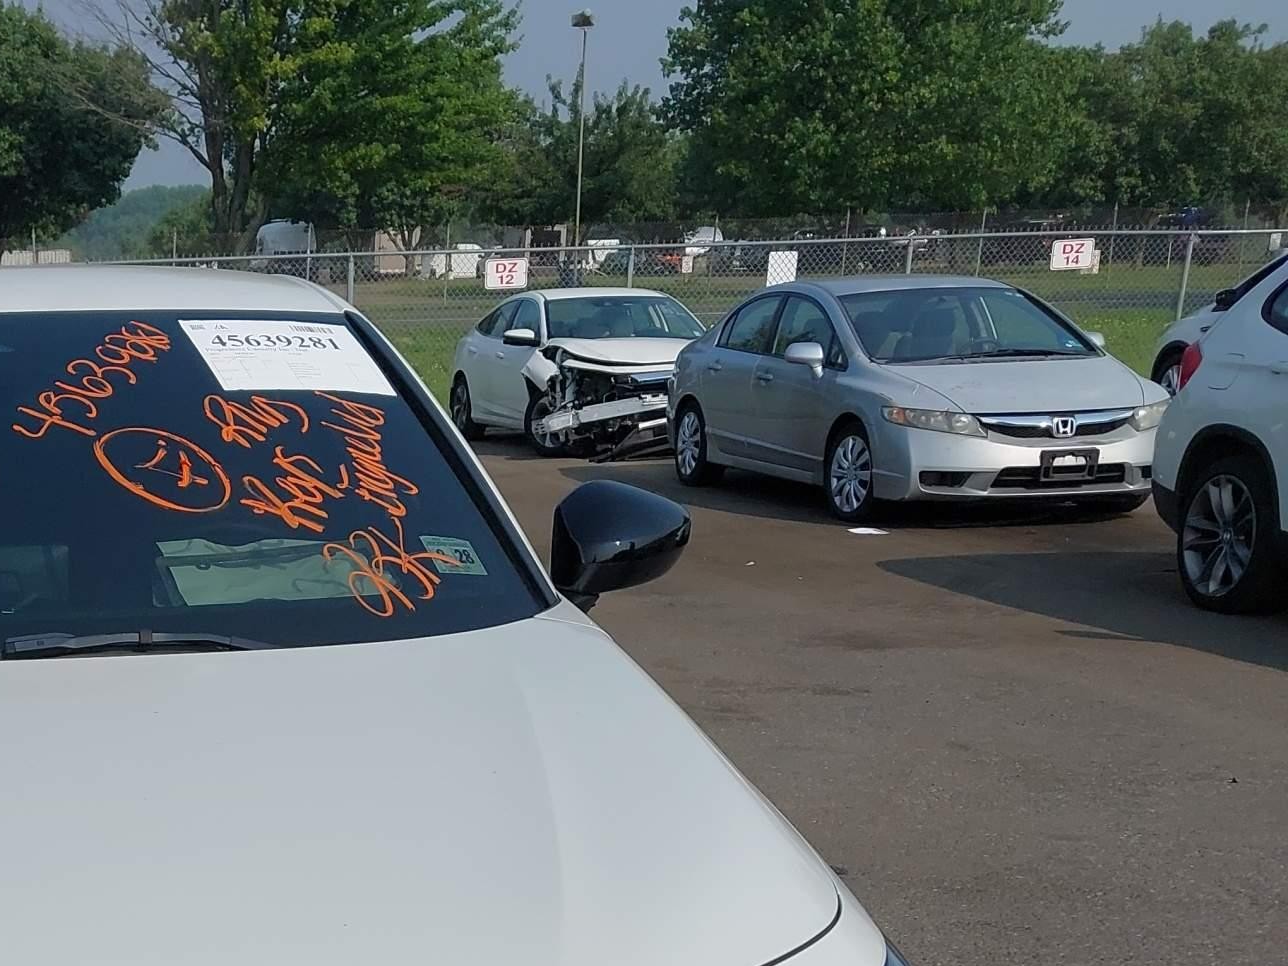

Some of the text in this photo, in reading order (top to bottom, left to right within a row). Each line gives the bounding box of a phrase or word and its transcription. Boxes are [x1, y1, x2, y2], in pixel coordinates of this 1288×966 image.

[1063, 243, 1085, 254] DZ
[1064, 255, 1080, 265] 14
[496, 262, 518, 273] DZ
[498, 274, 515, 285] 12
[210, 333, 344, 351] 45639281
[454, 549, 474, 564] 28
